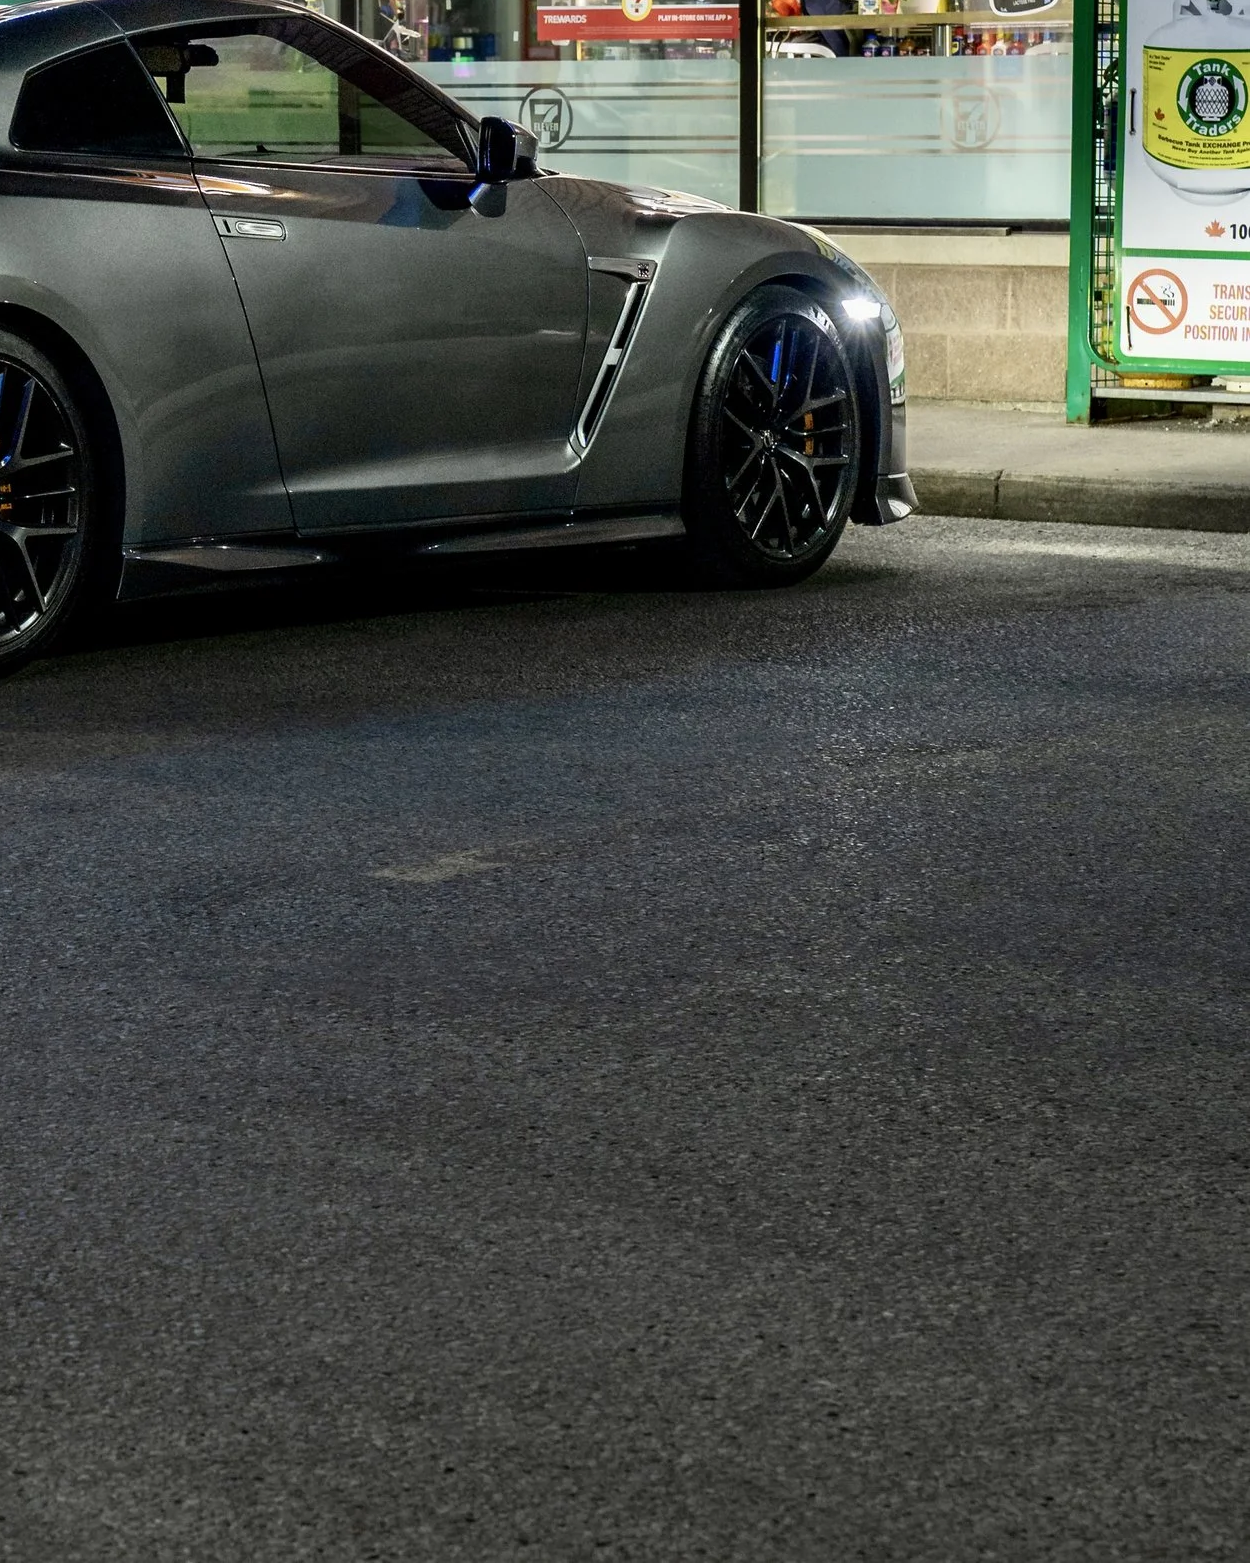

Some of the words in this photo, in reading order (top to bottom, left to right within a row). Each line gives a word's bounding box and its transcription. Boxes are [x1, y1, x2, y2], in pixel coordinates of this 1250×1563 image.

[1192, 63, 1231, 76] Tank
[1185, 113, 1241, 136] Traders
[1184, 140, 1200, 148] Tank
[1184, 324, 1238, 342] POSITION
